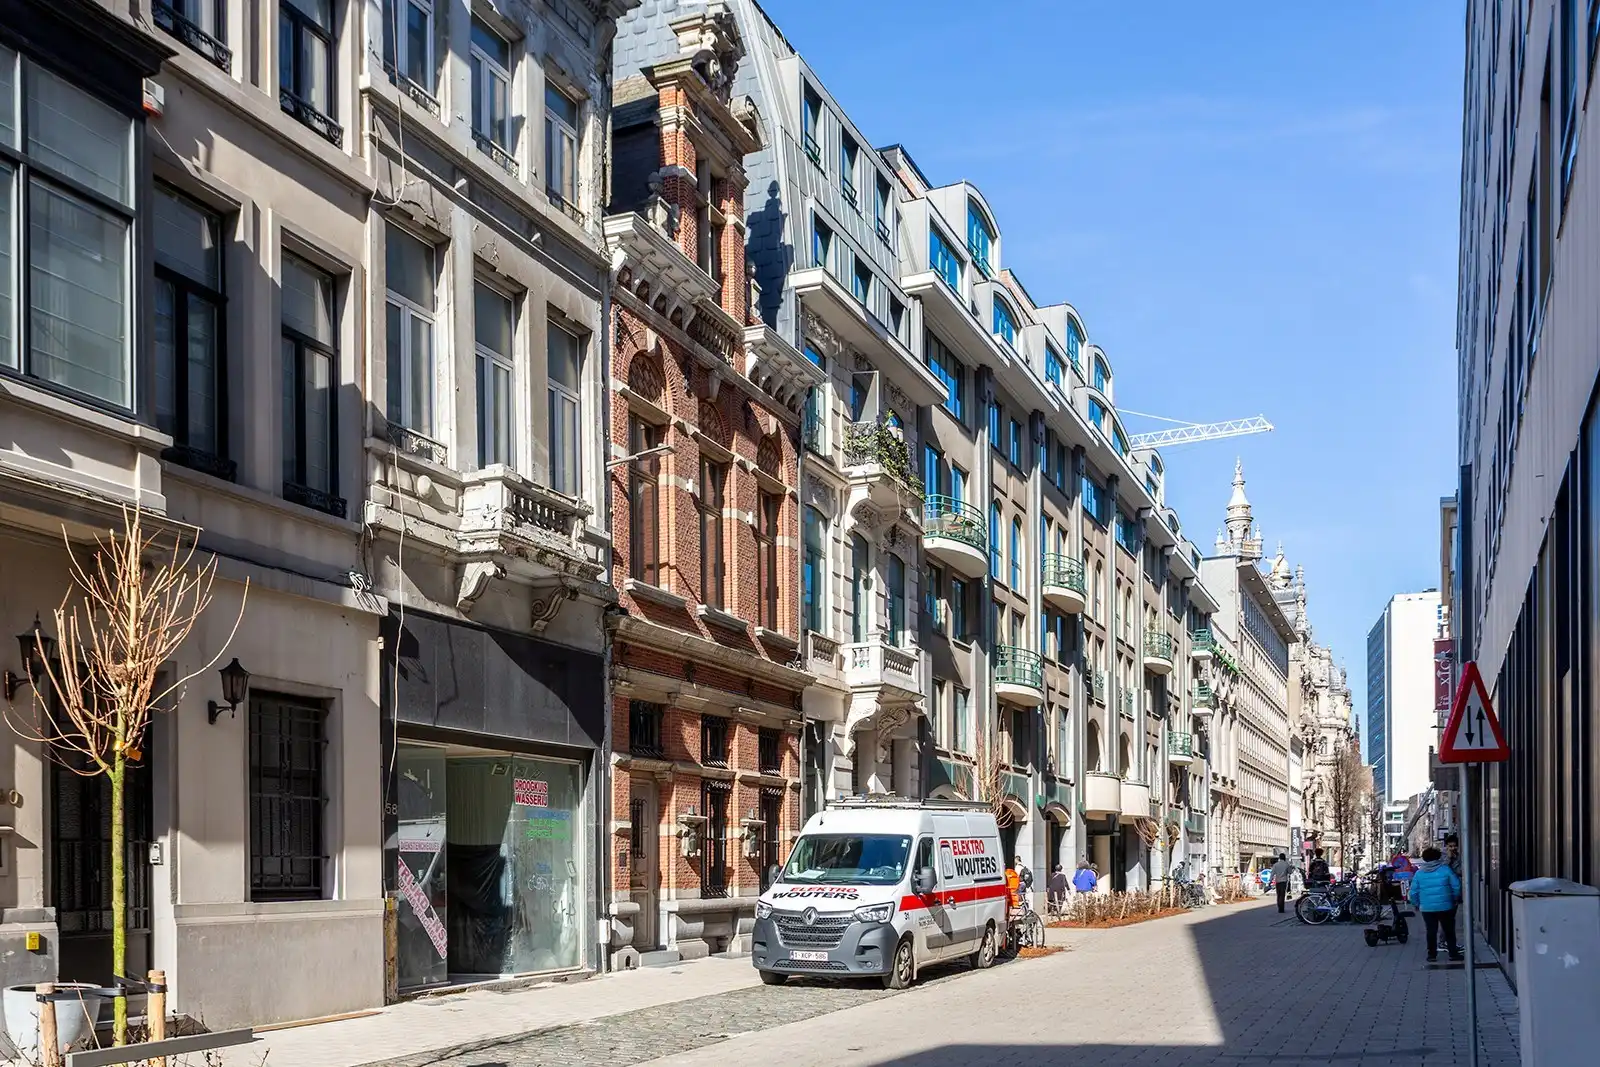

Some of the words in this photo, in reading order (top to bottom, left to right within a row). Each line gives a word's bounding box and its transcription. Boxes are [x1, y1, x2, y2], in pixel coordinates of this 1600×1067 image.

[514, 779, 547, 793] DROOGKUIS
[515, 793, 548, 806] WASSERIJ
[385, 803, 398, 815] 58
[951, 839, 985, 856] ELEKTRO
[954, 856, 997, 876] WOUTERS
[772, 891, 860, 901] WOUTERS
